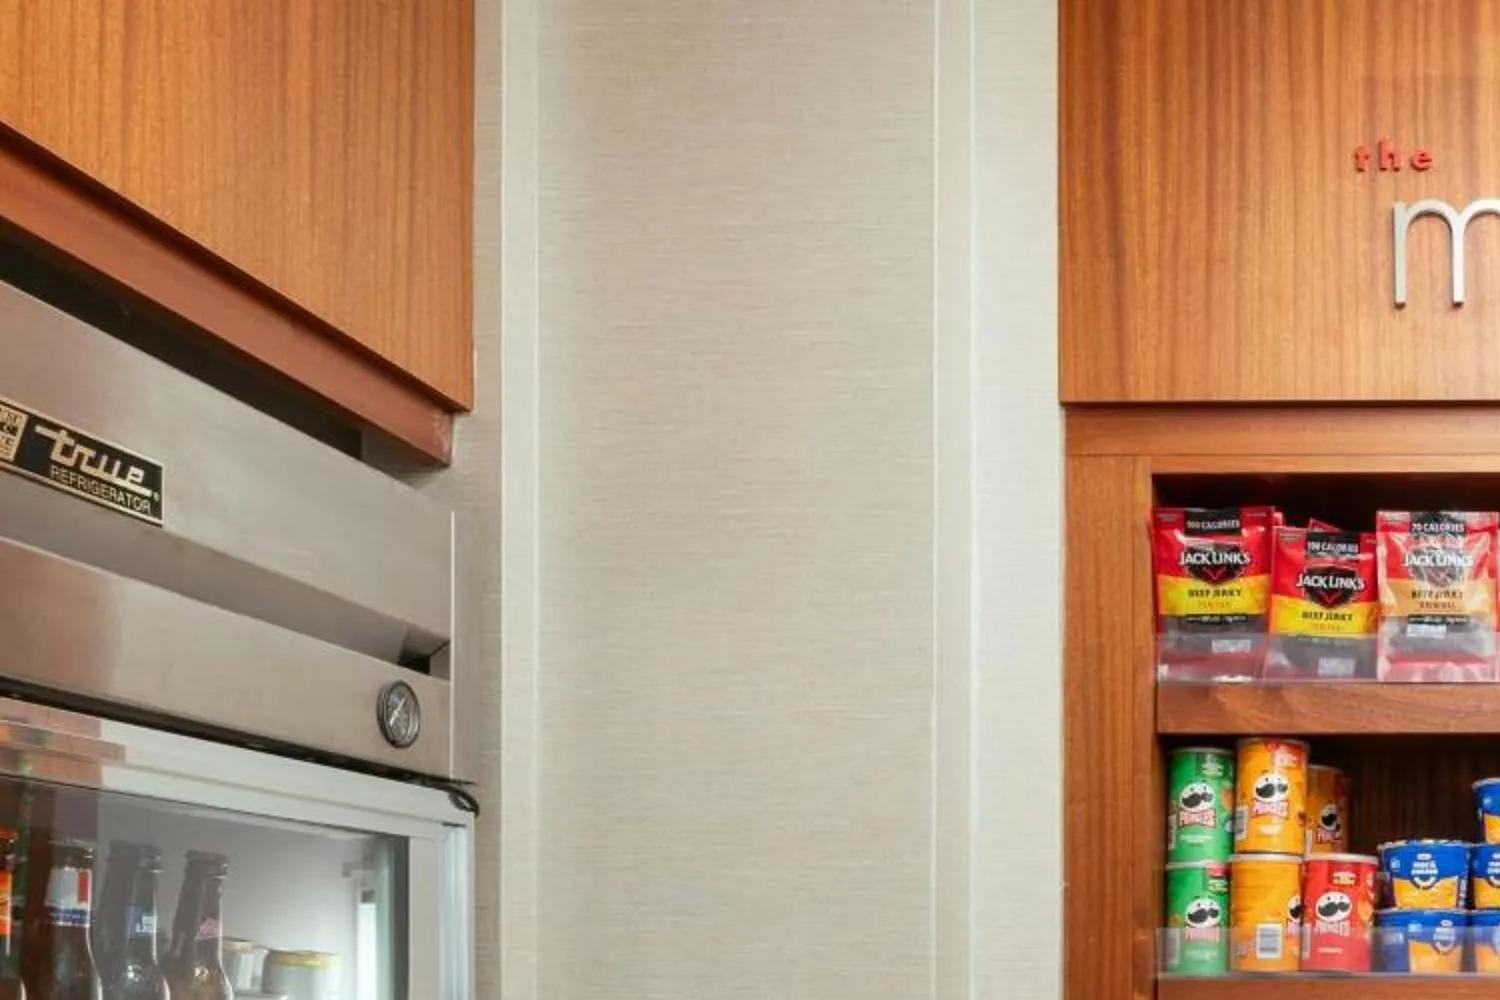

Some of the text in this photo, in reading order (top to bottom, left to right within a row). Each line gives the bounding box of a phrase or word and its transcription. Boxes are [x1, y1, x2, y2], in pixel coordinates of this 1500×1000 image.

[1354, 140, 1433, 173] the
[51, 466, 151, 514] REFRIGERATOR
[1179, 551, 1211, 565] JACK
[1404, 553, 1435, 567] JACK
[1296, 574, 1328, 588] JACK
